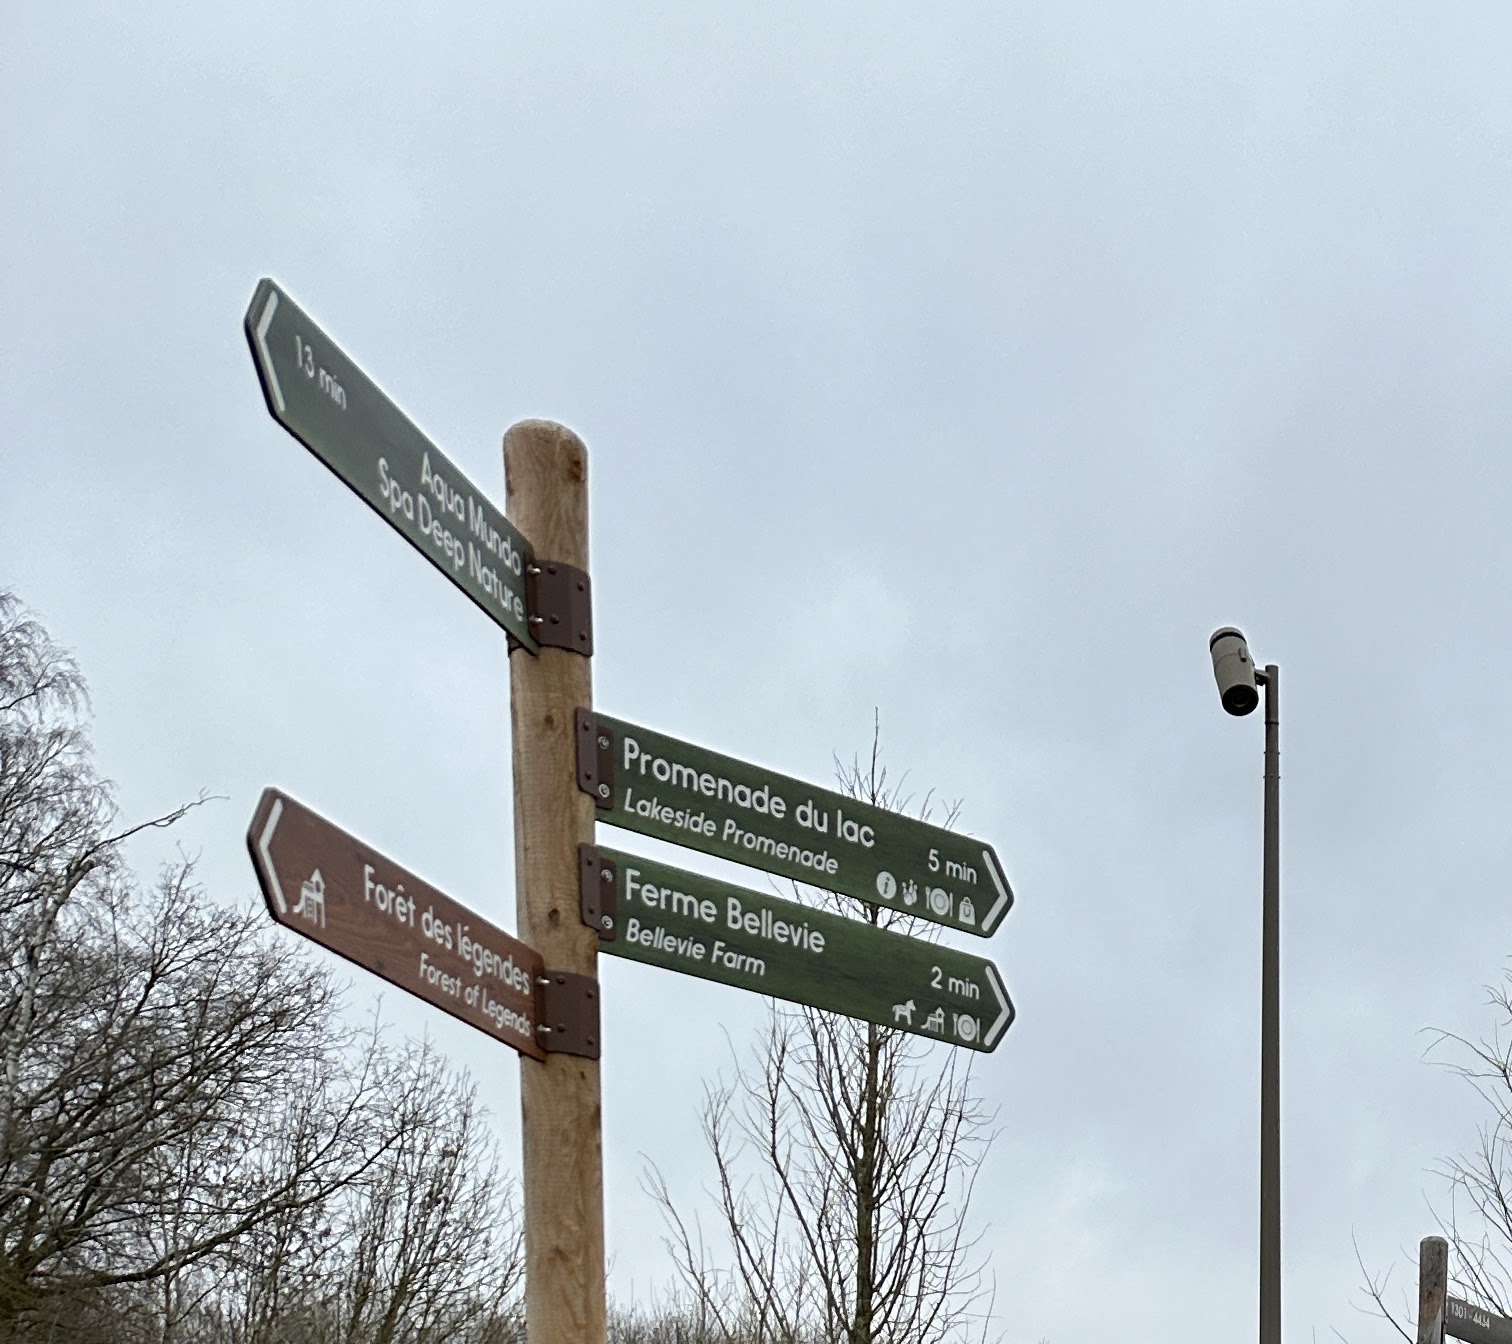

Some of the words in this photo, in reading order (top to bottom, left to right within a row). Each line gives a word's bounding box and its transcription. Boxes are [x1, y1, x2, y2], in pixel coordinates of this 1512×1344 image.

[295, 335, 315, 378] 13
[320, 367, 347, 410] min
[378, 457, 414, 521] Spa
[418, 492, 465, 571] Deep
[469, 541, 523, 622] Nature
[421, 452, 465, 522] Aqua
[469, 496, 521, 576] Mundo
[623, 737, 787, 818] Promenade
[796, 800, 829, 833] du
[837, 809, 875, 848] lac
[624, 788, 717, 836] Lakeside
[722, 818, 839, 874] Promenade
[928, 848, 940, 872] 5
[945, 861, 978, 884] min
[364, 864, 416, 927] Forêt
[422, 905, 453, 949] des
[457, 923, 530, 995] légendes
[625, 868, 718, 923] Ferme
[727, 897, 826, 953] Bellevie
[626, 917, 706, 959] Bellevie
[711, 940, 766, 976] Farm
[419, 952, 461, 997] Forest
[464, 984, 480, 1008] of
[482, 988, 530, 1037] Legends
[931, 965, 942, 989] 2
[948, 976, 980, 1000] min
